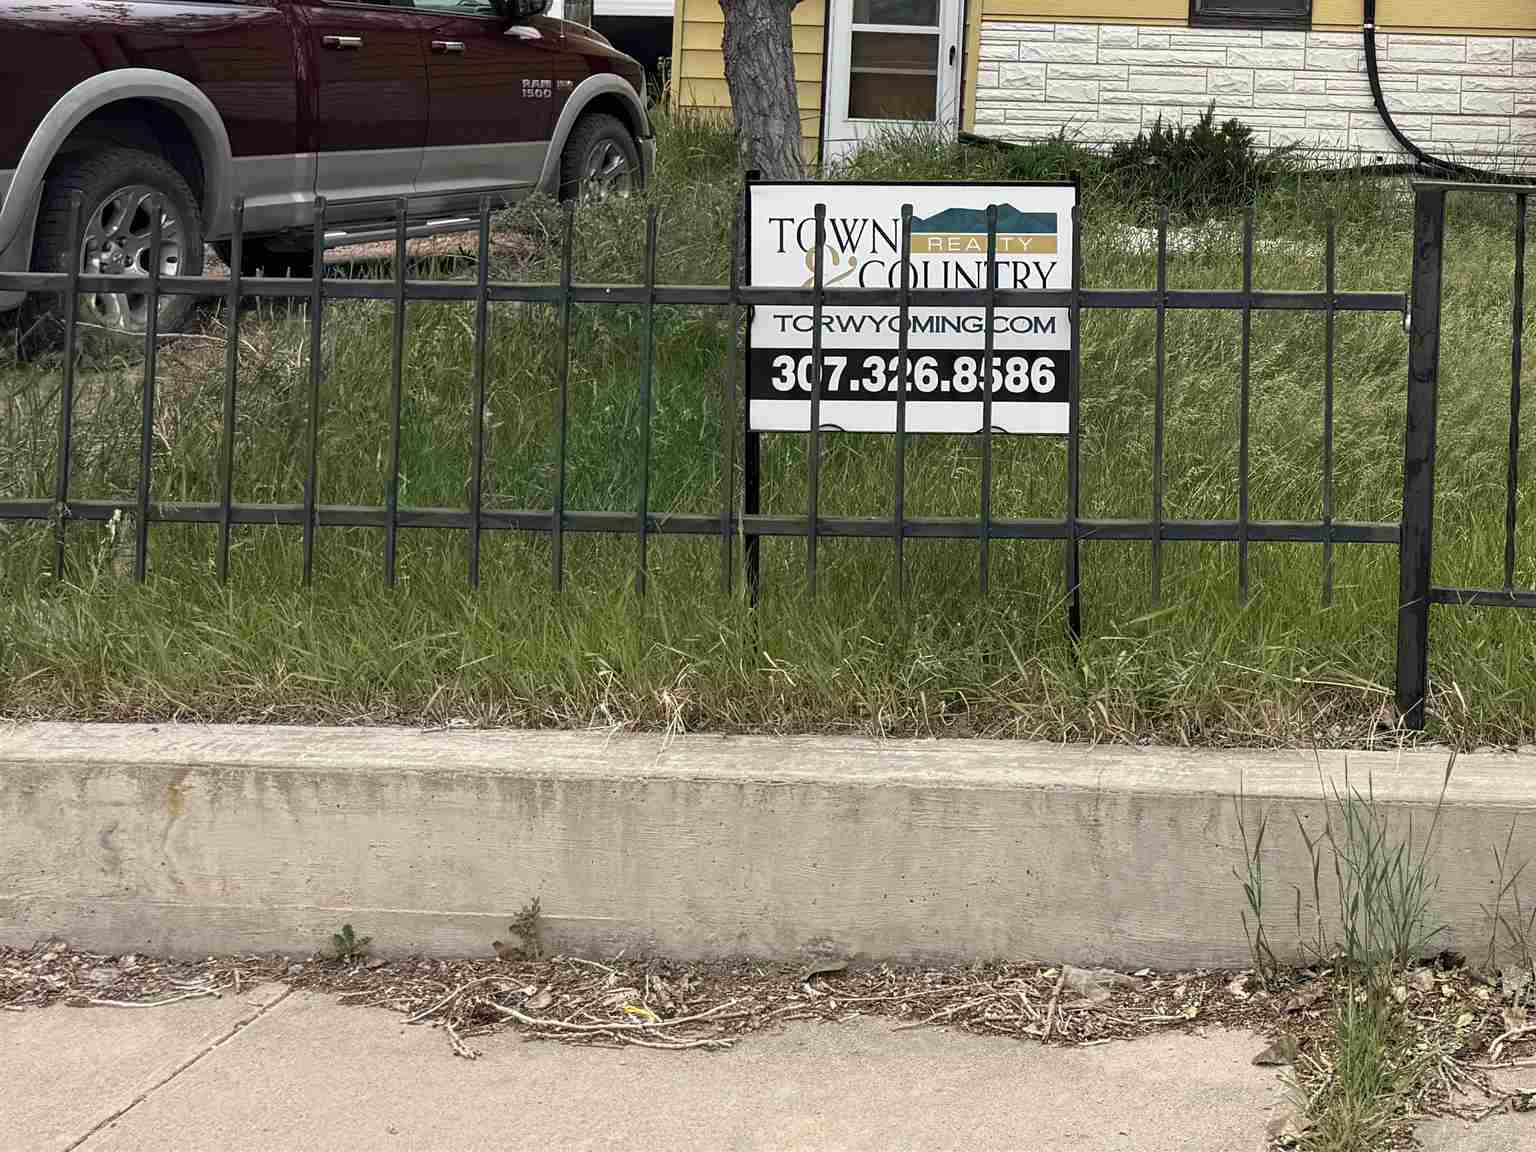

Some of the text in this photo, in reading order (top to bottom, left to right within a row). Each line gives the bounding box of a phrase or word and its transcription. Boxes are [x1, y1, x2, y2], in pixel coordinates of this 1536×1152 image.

[522, 79, 552, 88] RAM
[522, 88, 552, 98] 1500
[768, 217, 901, 254] TOWN
[928, 236, 1033, 252] REATY
[858, 259, 1057, 289] COUNTRY
[771, 354, 1056, 394] 307.326.8586
